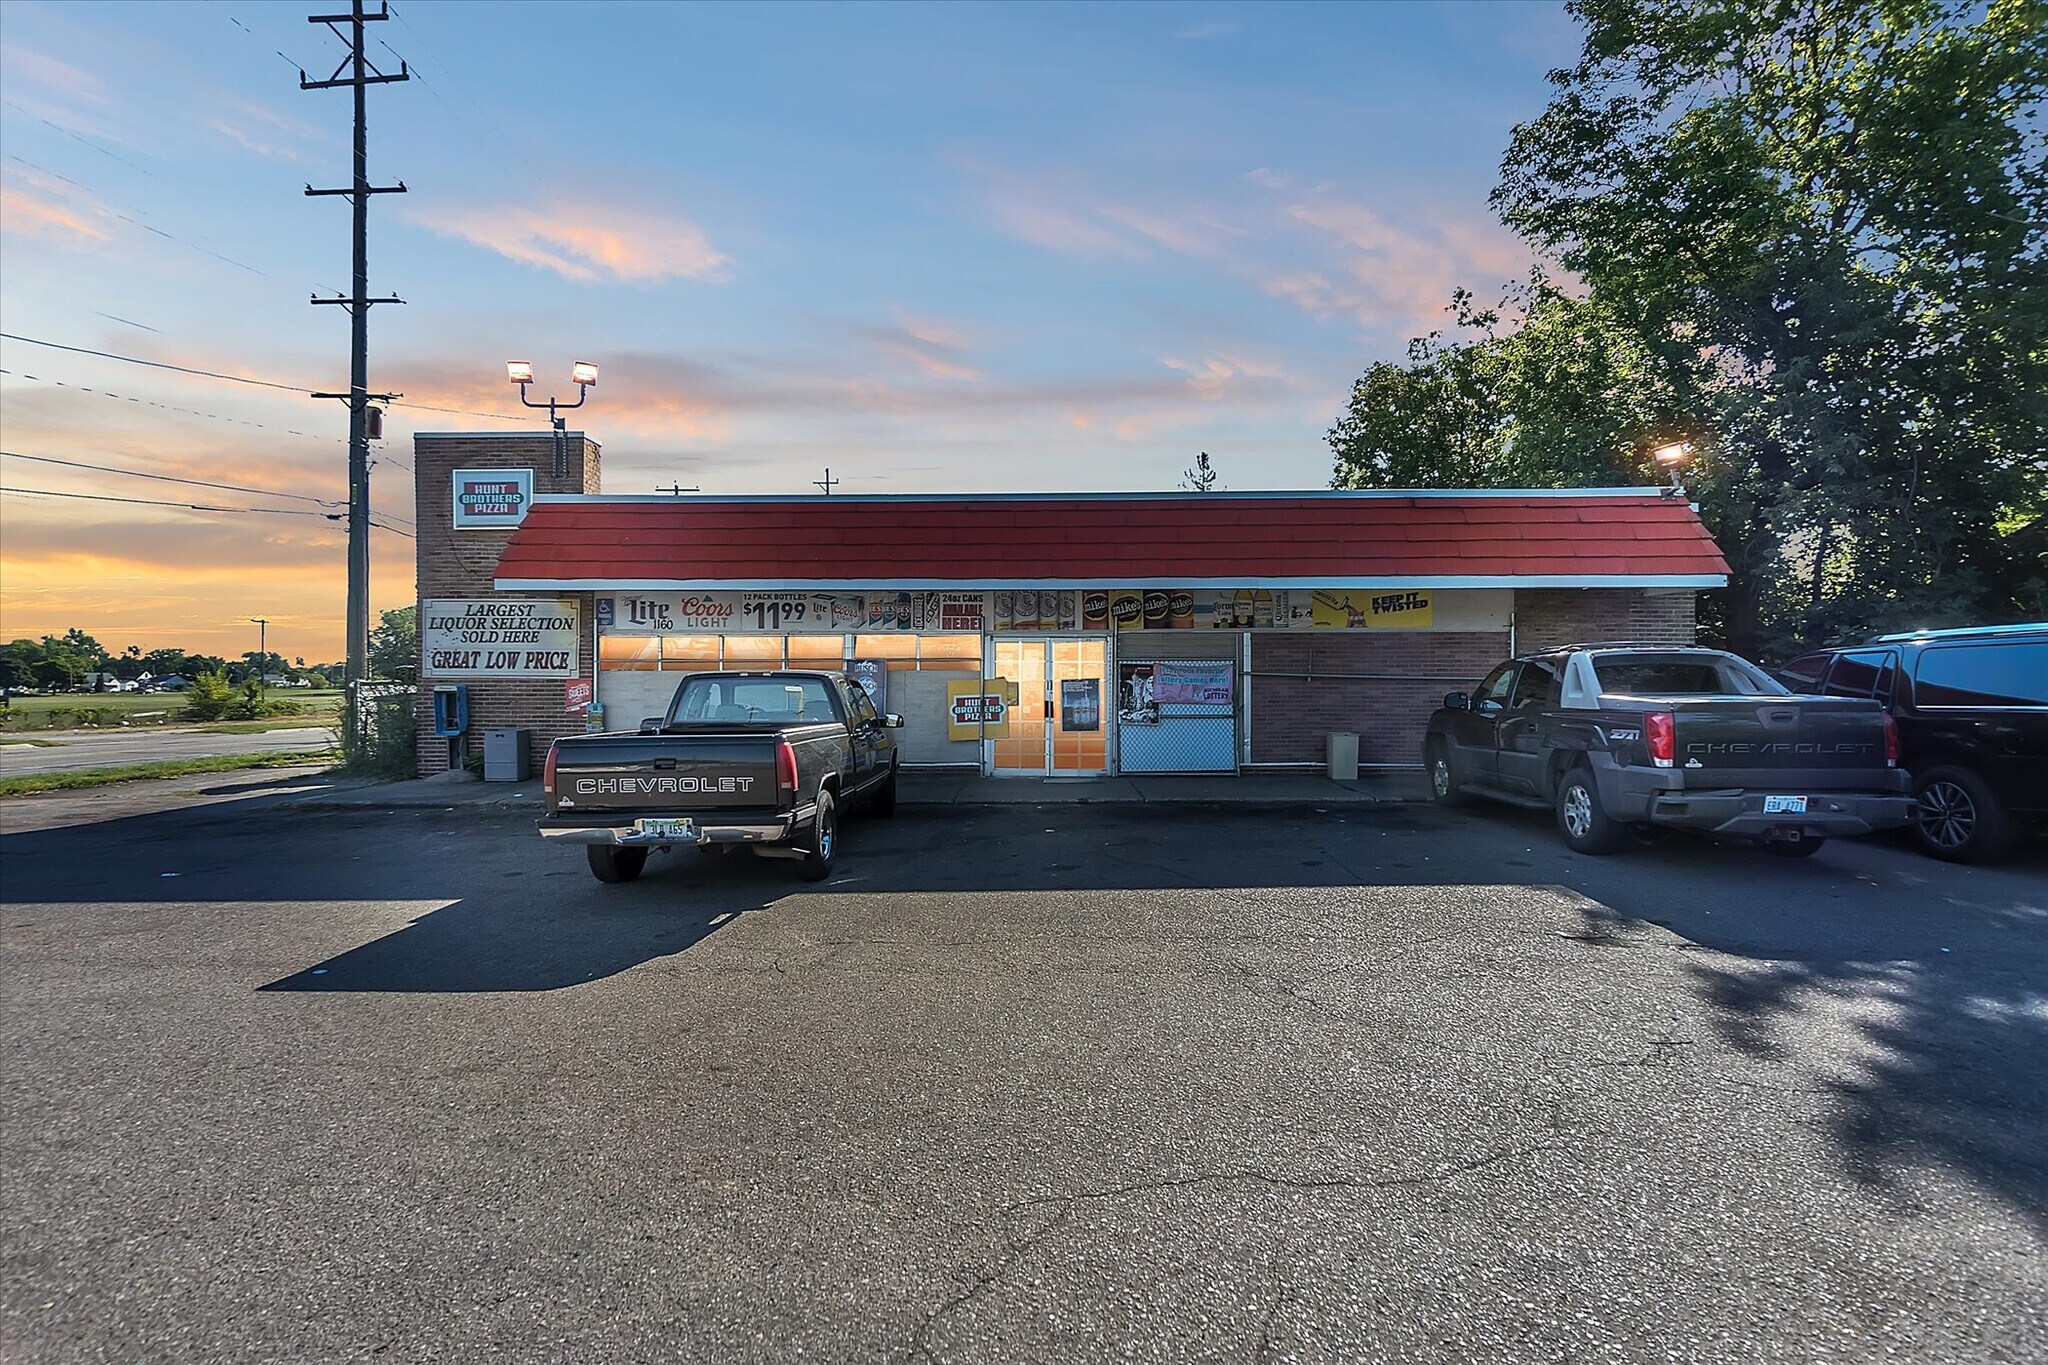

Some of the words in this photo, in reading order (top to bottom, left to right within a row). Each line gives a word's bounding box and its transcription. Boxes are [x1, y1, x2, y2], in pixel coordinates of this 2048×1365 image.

[474, 484, 507, 494] HUNT
[462, 494, 521, 503] BROTHERS
[474, 504, 508, 513] PIZZA
[962, 594, 984, 603] CANS
[1371, 594, 1404, 610] KEEP
[1405, 592, 1420, 602] IT
[465, 604, 536, 617] LARGEST
[628, 599, 670, 625] Lite
[681, 597, 734, 617] Coors
[1112, 601, 1141, 615] mike's
[1373, 600, 1429, 615] TWISTED
[428, 617, 487, 632] LIQUOR
[490, 617, 575, 630] SELECTION
[653, 619, 674, 630] 1160
[687, 618, 728, 628] LIGHT
[460, 631, 503, 643] SOLD
[501, 631, 540, 643] HERE
[432, 650, 481, 669] GREAT
[485, 651, 521, 669] LOW
[524, 651, 570, 670] PRICE
[955, 706, 1001, 714] BROTERS
[1686, 743, 1875, 755] CHEVROLET
[576, 777, 754, 794] CHEVROLET
